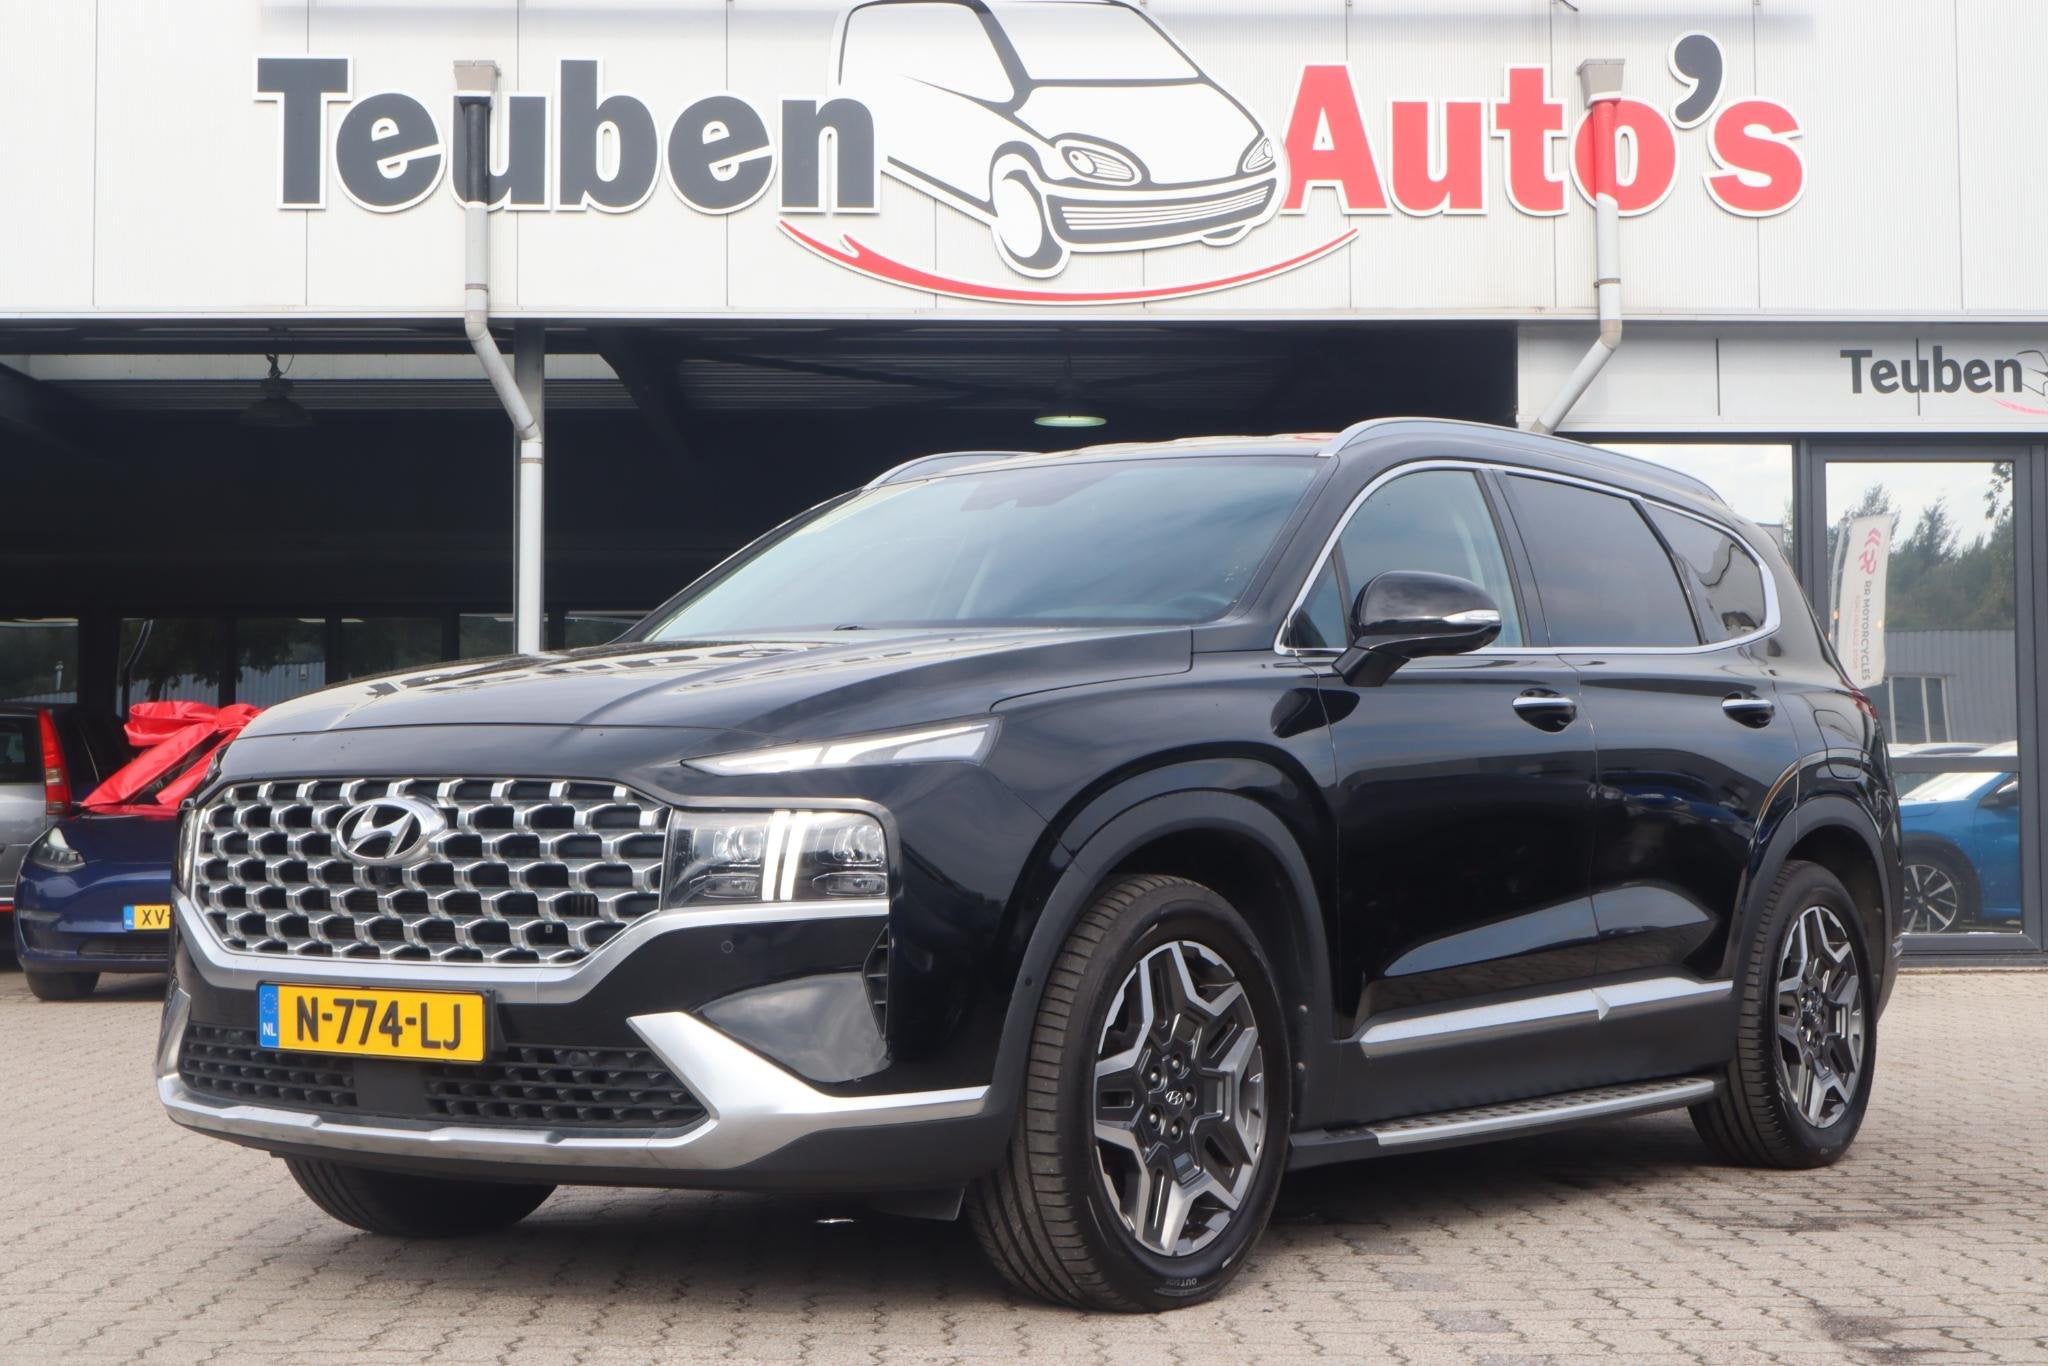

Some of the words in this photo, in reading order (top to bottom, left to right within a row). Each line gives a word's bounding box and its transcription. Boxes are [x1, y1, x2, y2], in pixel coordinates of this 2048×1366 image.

[256, 57, 875, 210] Teuben
[1281, 34, 1804, 214] Auto's
[1840, 345, 2023, 394] Teuben
[1860, 598, 1872, 681] MOTORCYCLES
[262, 1022, 277, 1037] NL
[296, 994, 461, 1051] N-774-LJ
